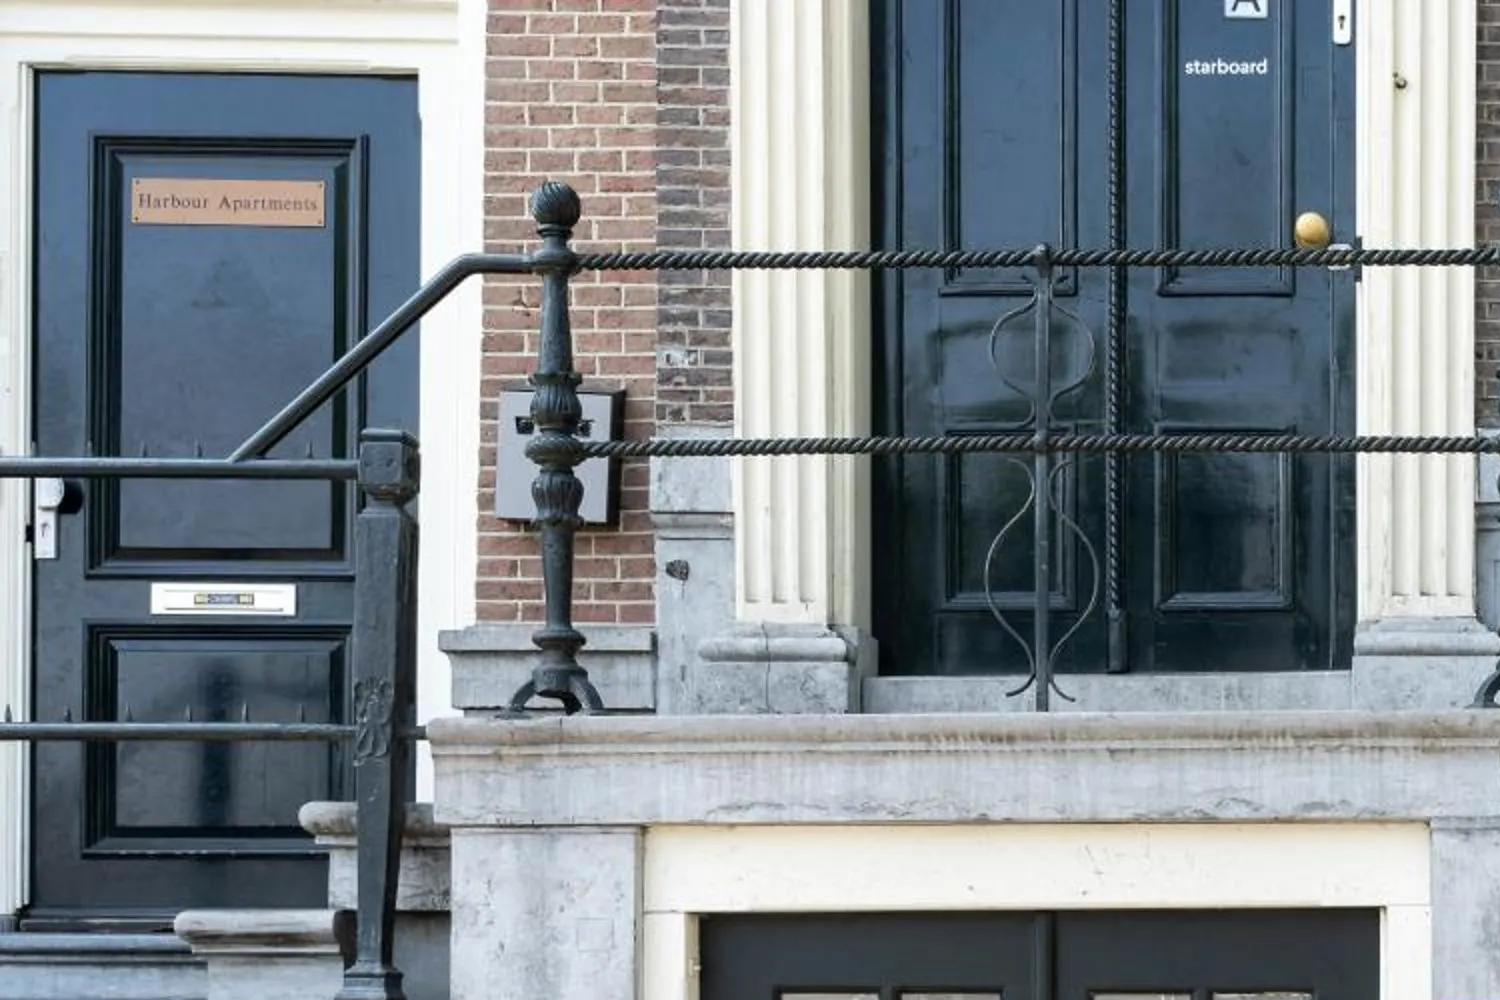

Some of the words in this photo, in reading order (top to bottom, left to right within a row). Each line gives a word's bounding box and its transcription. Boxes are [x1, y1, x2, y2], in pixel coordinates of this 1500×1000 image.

[1184, 58, 1268, 75] starboard
[138, 193, 209, 209] Harbour
[218, 194, 318, 214] Apartments
